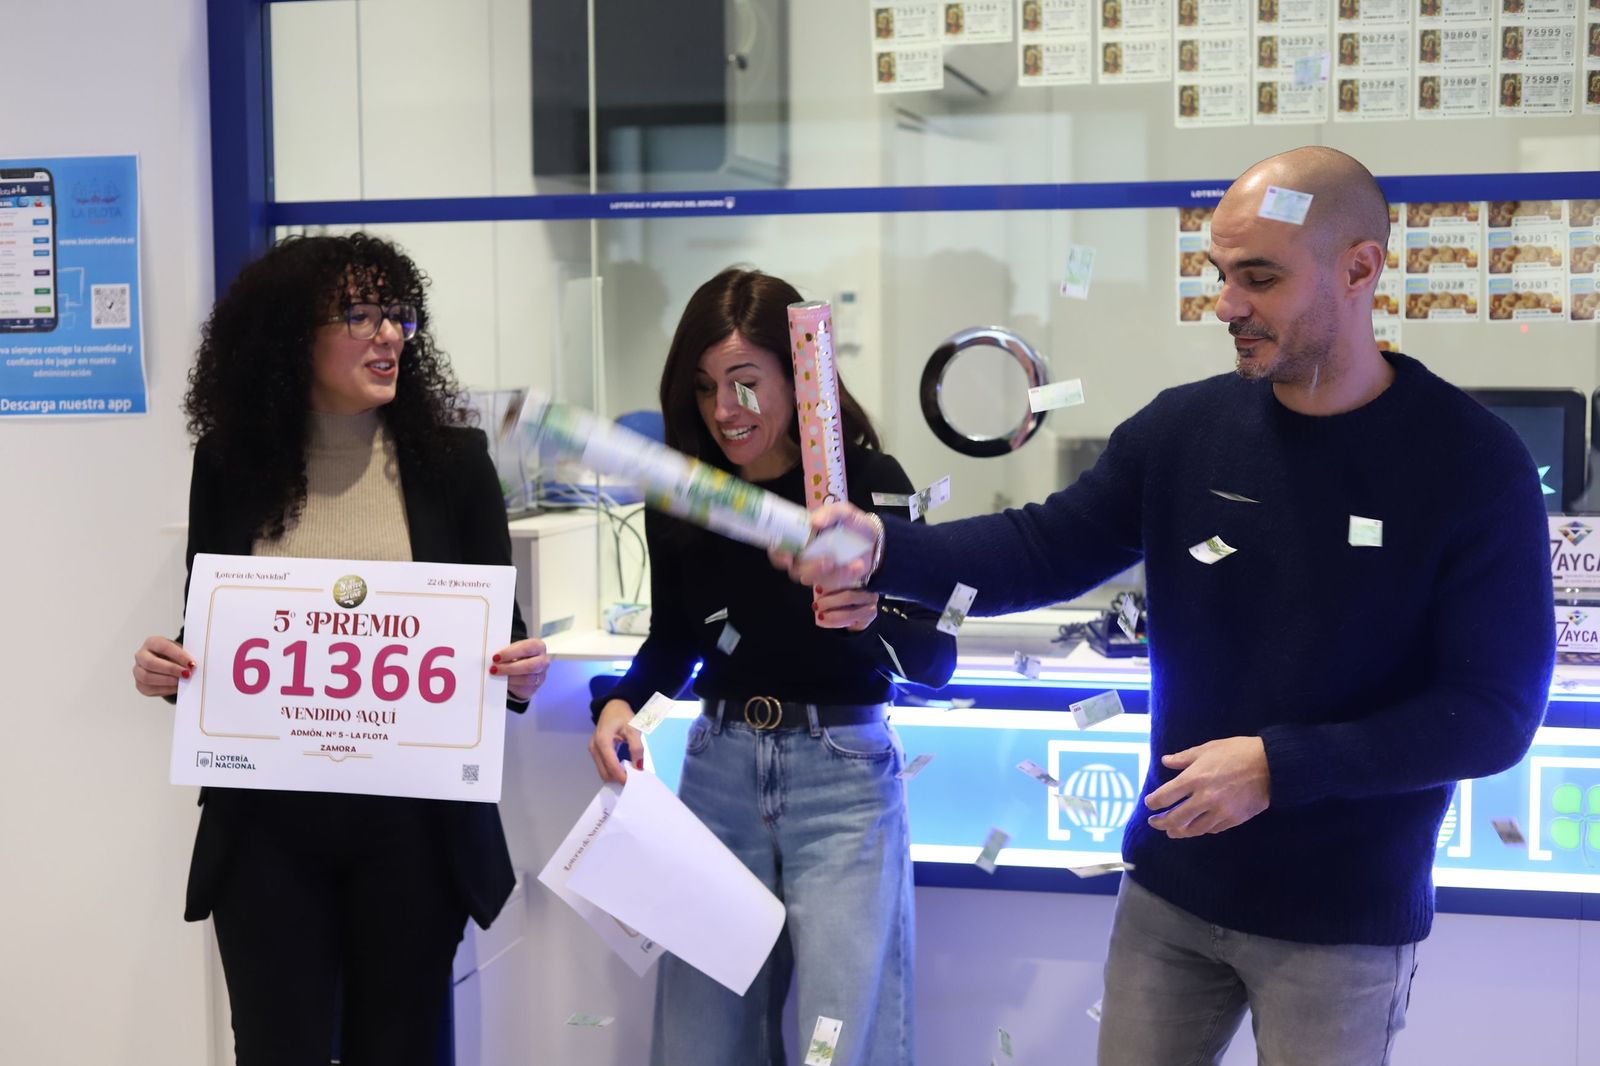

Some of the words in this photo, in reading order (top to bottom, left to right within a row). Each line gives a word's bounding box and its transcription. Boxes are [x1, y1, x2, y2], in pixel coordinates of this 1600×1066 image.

[0, 398, 56, 413] Descarga
[59, 398, 105, 411] nuestra
[108, 399, 132, 412] app
[245, 571, 254, 580] de
[427, 578, 437, 586] 22
[437, 578, 447, 587] de
[306, 611, 420, 639] PREMIO
[1556, 622, 1598, 646] ZAYCA
[232, 638, 457, 704] 61366
[281, 706, 351, 722] VENDIDO
[356, 707, 396, 727] AQUÍ
[290, 728, 324, 738] ADMÓN.
[350, 731, 361, 739] LA
[362, 732, 389, 740] FLOTA
[320, 744, 357, 753] ZAMORA
[215, 754, 248, 763] LOTERÍA
[215, 761, 256, 770] NACIONAL
